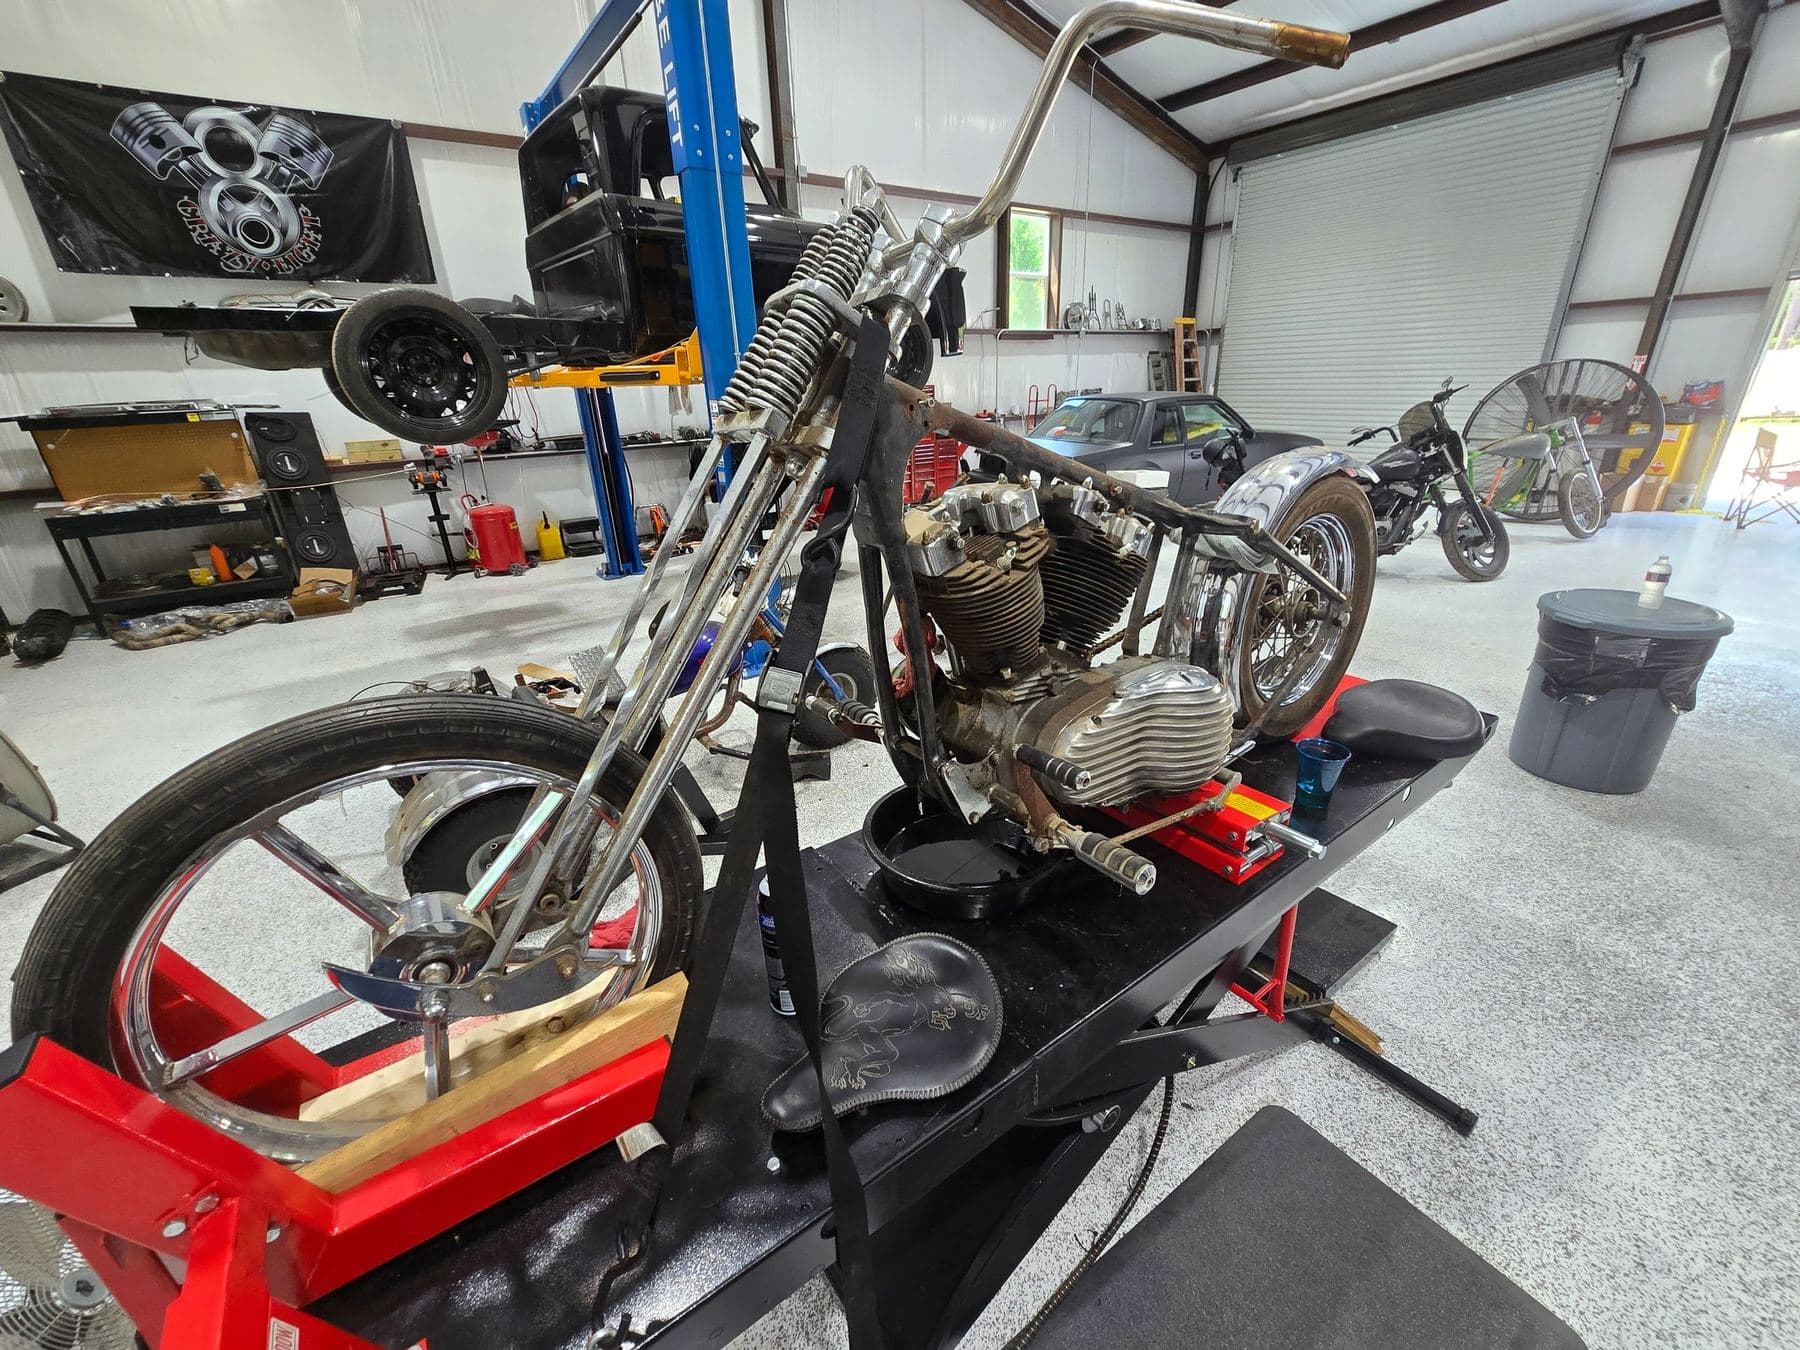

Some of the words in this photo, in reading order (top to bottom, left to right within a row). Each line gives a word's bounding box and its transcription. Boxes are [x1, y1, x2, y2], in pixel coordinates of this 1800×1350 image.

[664, 61, 683, 147] LIFT
[176, 196, 259, 274] CRAZY
[272, 203, 322, 274] EIGHT
